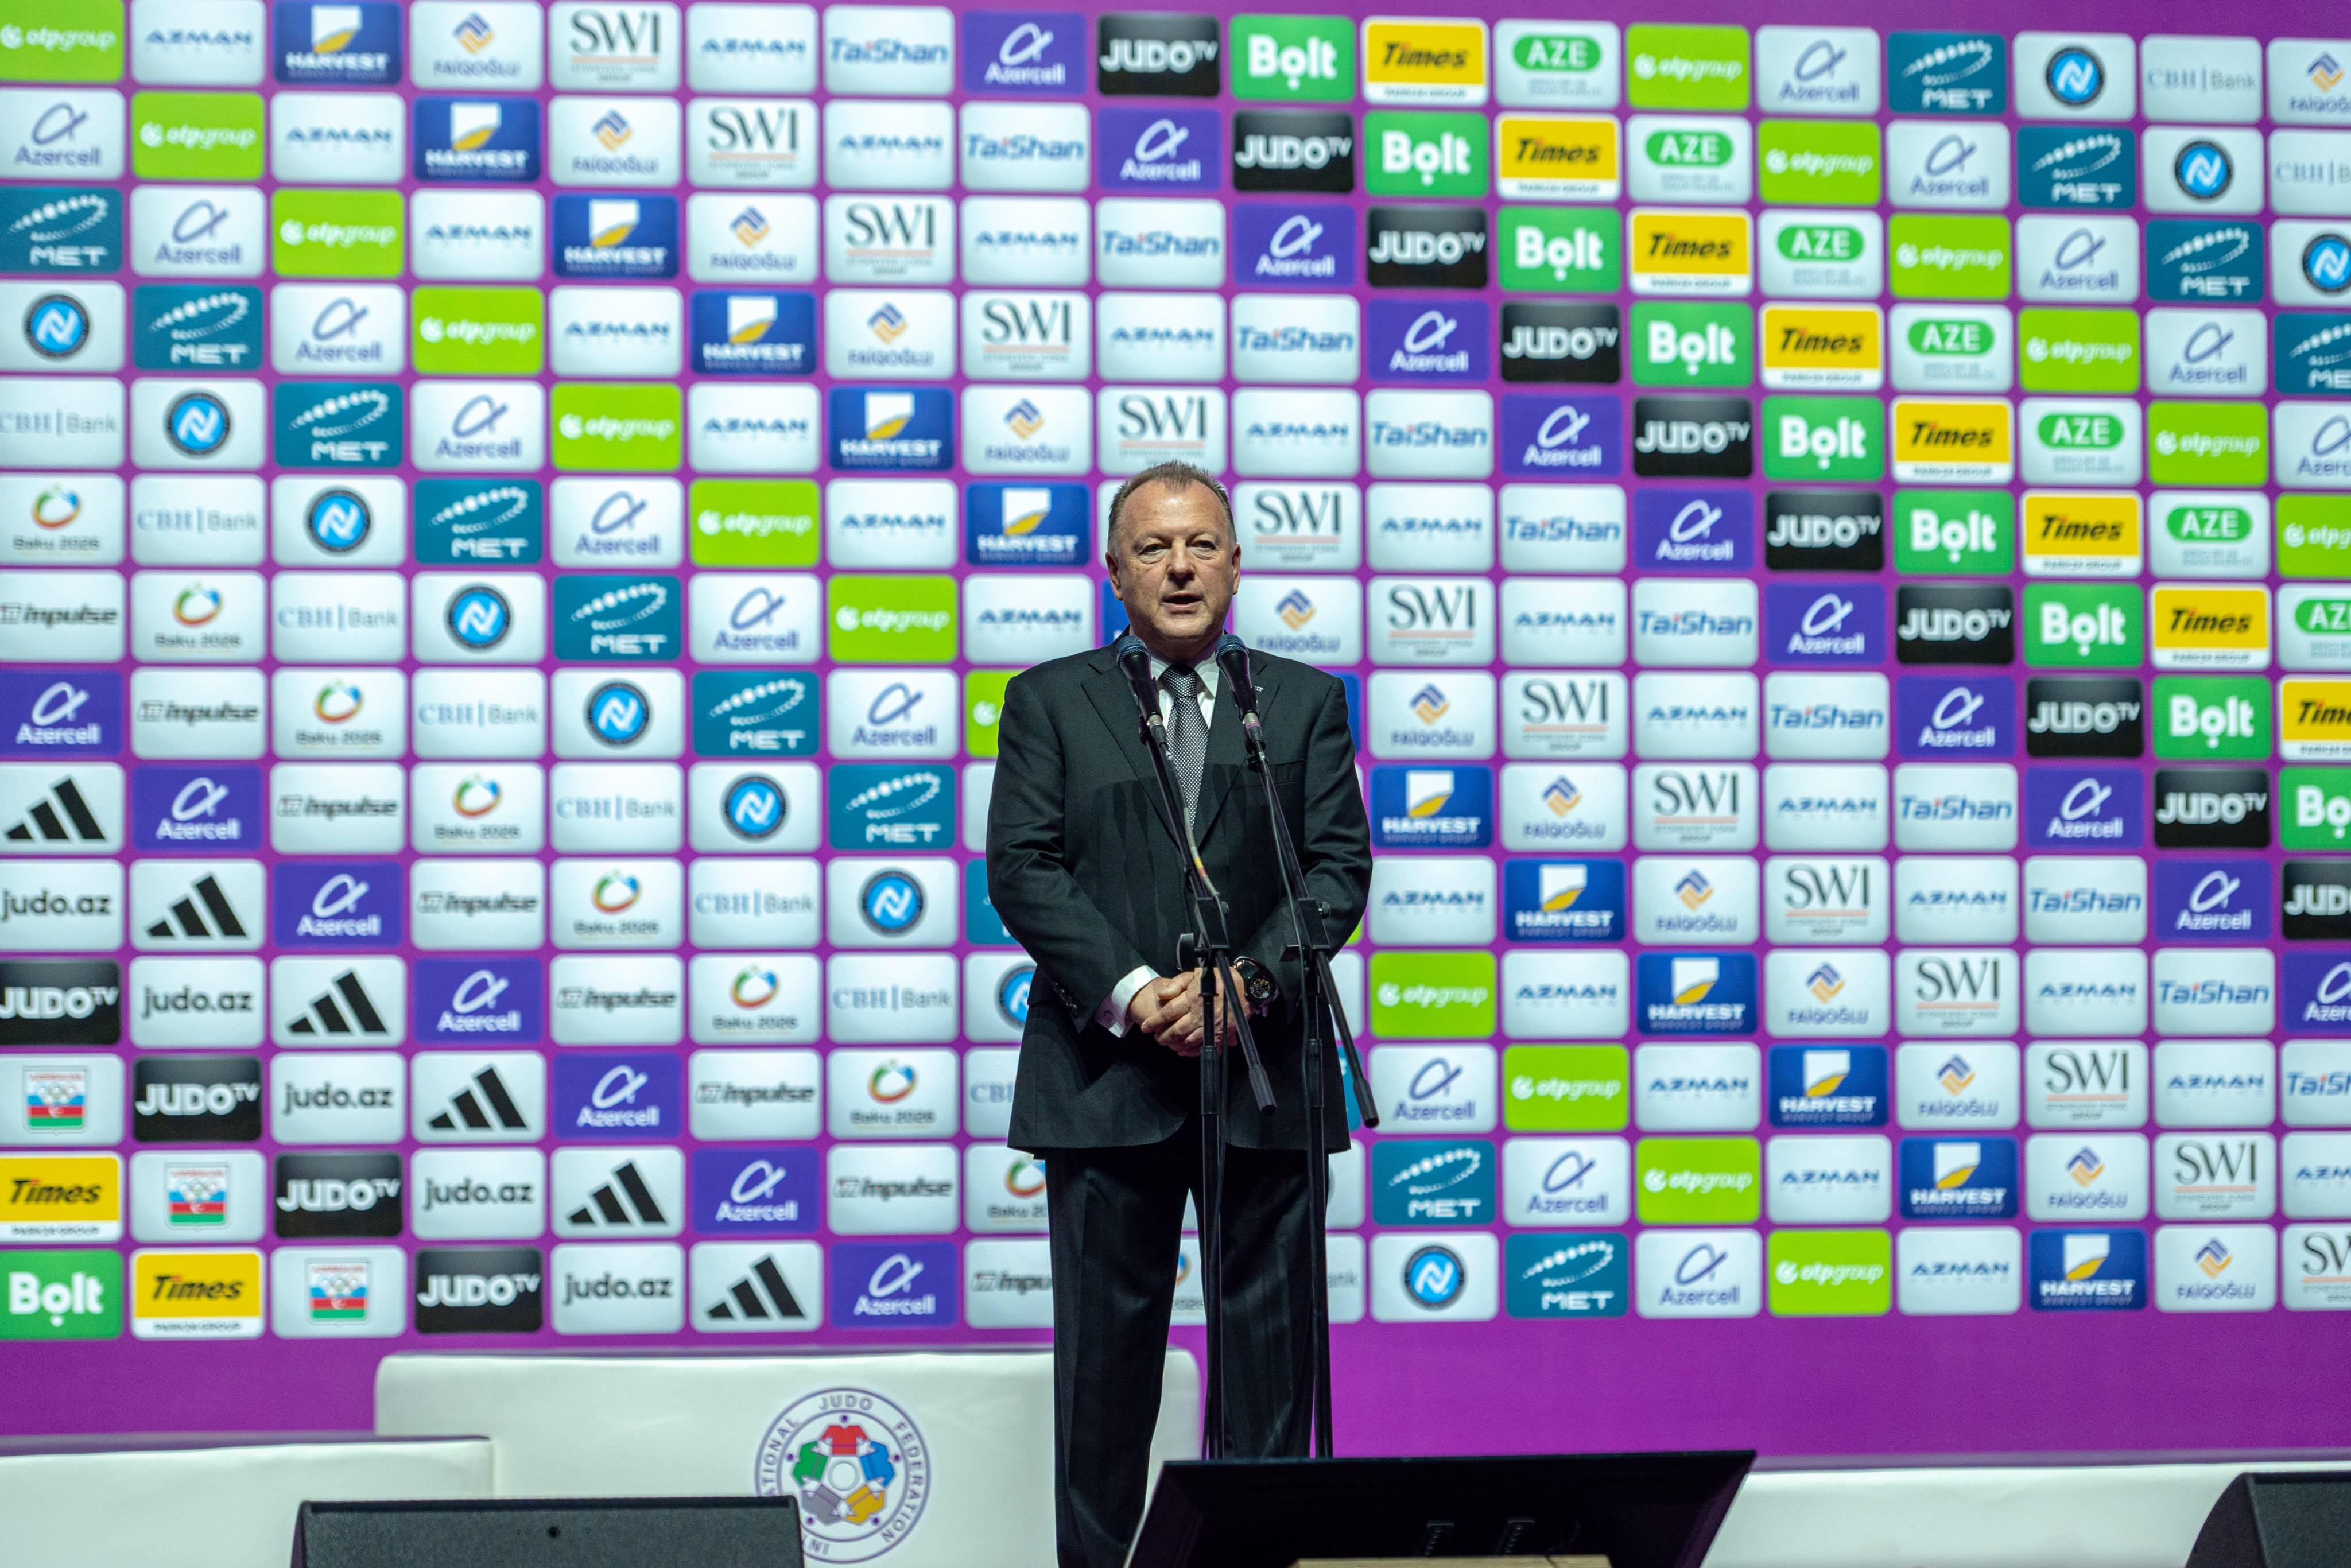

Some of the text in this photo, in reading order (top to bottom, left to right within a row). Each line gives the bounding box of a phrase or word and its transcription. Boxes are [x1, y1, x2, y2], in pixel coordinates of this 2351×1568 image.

[571, 9, 661, 55] SWI
[286, 52, 389, 71] HARVEST
[829, 37, 949, 64] TaiShan
[1248, 34, 1337, 91] Bolt
[1382, 41, 1469, 69] Times
[1526, 37, 1588, 68] AZE
[984, 64, 1065, 84] Azercell
[1779, 80, 1859, 101] Azercell
[1922, 87, 1993, 108] MET
[1658, 133, 1720, 163] AZE
[1910, 175, 1989, 195] Azercell
[845, 203, 935, 248] SWI
[29, 244, 107, 267] MET
[564, 246, 666, 265] HARVEST
[1101, 230, 1220, 257] TaiShan
[1515, 226, 1604, 282] Bolt
[1647, 232, 1733, 259] Times
[1790, 228, 1851, 258] AZE
[1255, 256, 1335, 276] Azercell
[2040, 269, 2118, 289] Azercell
[2180, 275, 2250, 296] MET
[983, 299, 1071, 344] SWI
[1236, 325, 1354, 352] TaiShan
[1648, 320, 1736, 377] Bolt
[1779, 327, 1864, 354] Times
[1920, 322, 1981, 352] AZE
[2308, 368, 2351, 389] ME
[1779, 415, 1867, 471] Bolt
[1910, 420, 1995, 448] Times
[2050, 416, 2111, 445] AZE
[311, 440, 389, 461] MET
[437, 437, 522, 457] Azercell
[840, 439, 941, 457] HARVEST
[1523, 446, 1602, 466] Azercell
[2297, 456, 2351, 475] Azerc
[1254, 490, 1341, 534] SWI
[2179, 509, 2239, 538] AZE
[1504, 515, 1620, 542] TaiShan
[1910, 509, 1997, 564] Bolt
[2040, 514, 2124, 541] Times
[451, 536, 528, 558] MET
[977, 534, 1077, 553] HARVEST
[1388, 585, 1475, 628] SWI
[2169, 607, 2252, 633] Times
[715, 629, 798, 649] Azercell
[2040, 602, 2126, 657] Bolt
[1787, 634, 1865, 653] Azercell
[1521, 678, 1608, 722] SWI
[2296, 698, 2351, 725] Tim
[1769, 703, 1883, 728] TaiShan
[728, 728, 804, 749] MET
[1917, 727, 1995, 746] Azercell
[1899, 796, 2013, 821] TaiShan
[2296, 786, 2351, 840] Bo
[866, 822, 941, 844] MET
[2047, 820, 2124, 838] Azercell
[1785, 865, 1871, 908] SWI
[0, 891, 112, 923] judo.az
[2284, 885, 2351, 916] JUD
[1515, 911, 1613, 928] HARVEST
[2175, 911, 2252, 930] Azercell
[1915, 957, 2000, 1000] SWI
[2158, 980, 2269, 1004] TaiShan
[141, 987, 254, 1019] judo.az
[2303, 1002, 2351, 1021] Azer
[2045, 1049, 2129, 1092] SWI
[282, 1082, 394, 1116] judo.az
[1394, 1100, 1475, 1119] Azercell
[1779, 1096, 1876, 1113] HARVEST
[576, 1107, 659, 1127] Azercell
[2174, 1140, 2257, 1183] SWI
[2295, 1166, 2351, 1178] AZM
[9, 1176, 102, 1204] Times
[423, 1178, 534, 1211] judo.az
[1910, 1187, 2005, 1206] HARVEST
[152, 1272, 245, 1301] Times
[563, 1273, 673, 1307] judo.az
[1324, 1269, 1357, 1290] ank
[2040, 1279, 2135, 1298] HARVEST
[8, 1270, 104, 1329] Bolt
[854, 1295, 936, 1316] Azercell
[1541, 1290, 1615, 1311] MET
[1660, 1285, 1740, 1305] Azercell
[818, 1395, 874, 1411] JUDO
[882, 1421, 924, 1543] FEDERATION
